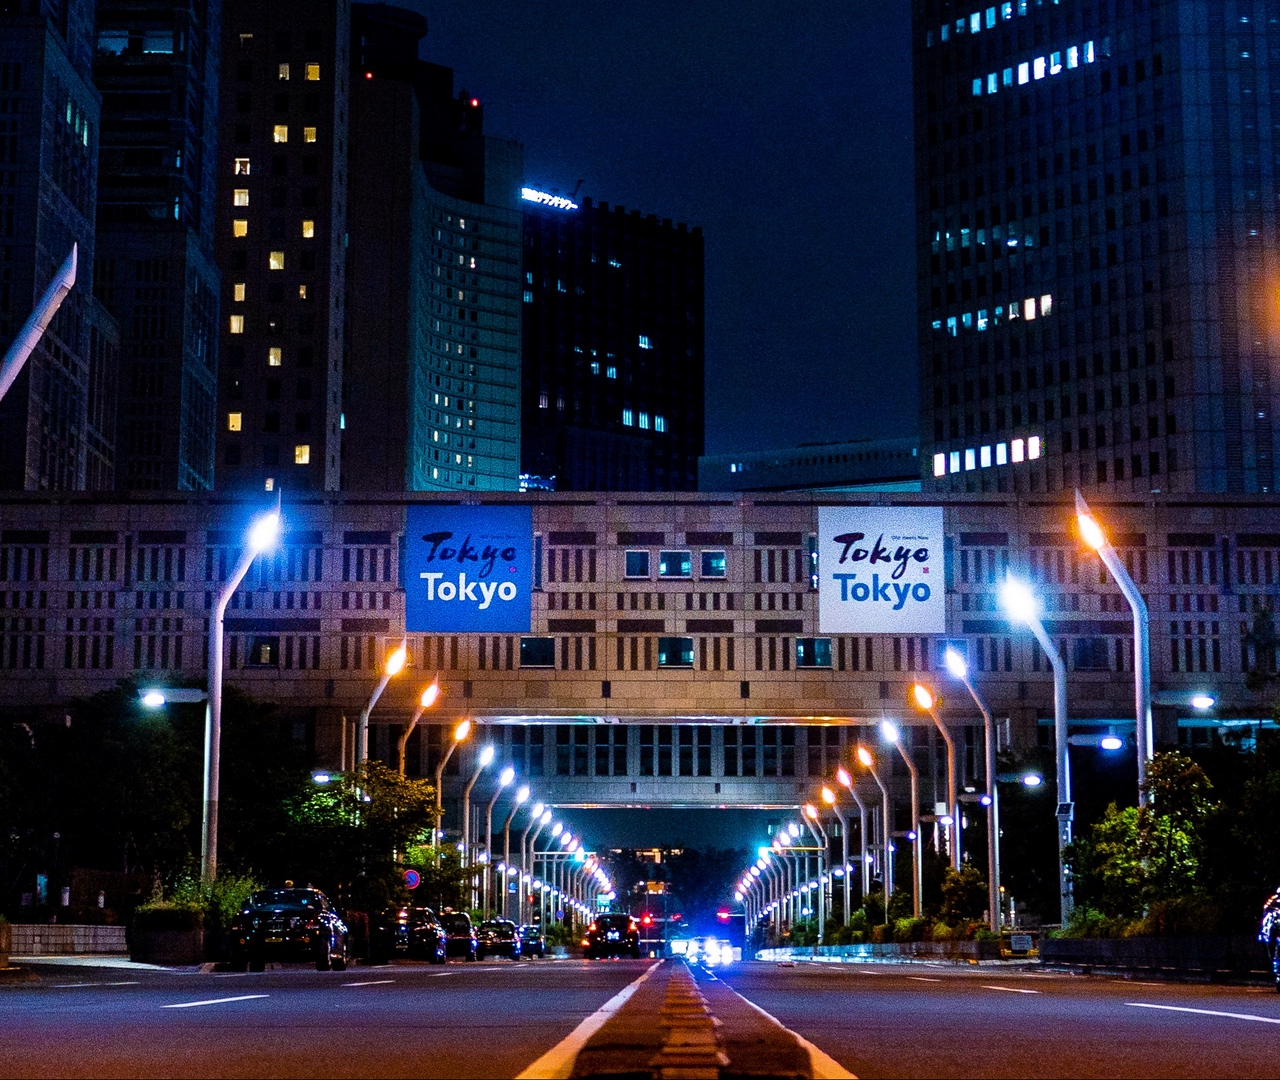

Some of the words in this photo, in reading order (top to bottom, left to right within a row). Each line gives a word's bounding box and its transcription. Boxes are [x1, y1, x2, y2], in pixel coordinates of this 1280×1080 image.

[421, 531, 517, 578] Tokyo
[833, 532, 930, 579] Tokyo
[419, 572, 517, 610] Tokyo
[832, 573, 931, 610] Tokyo
